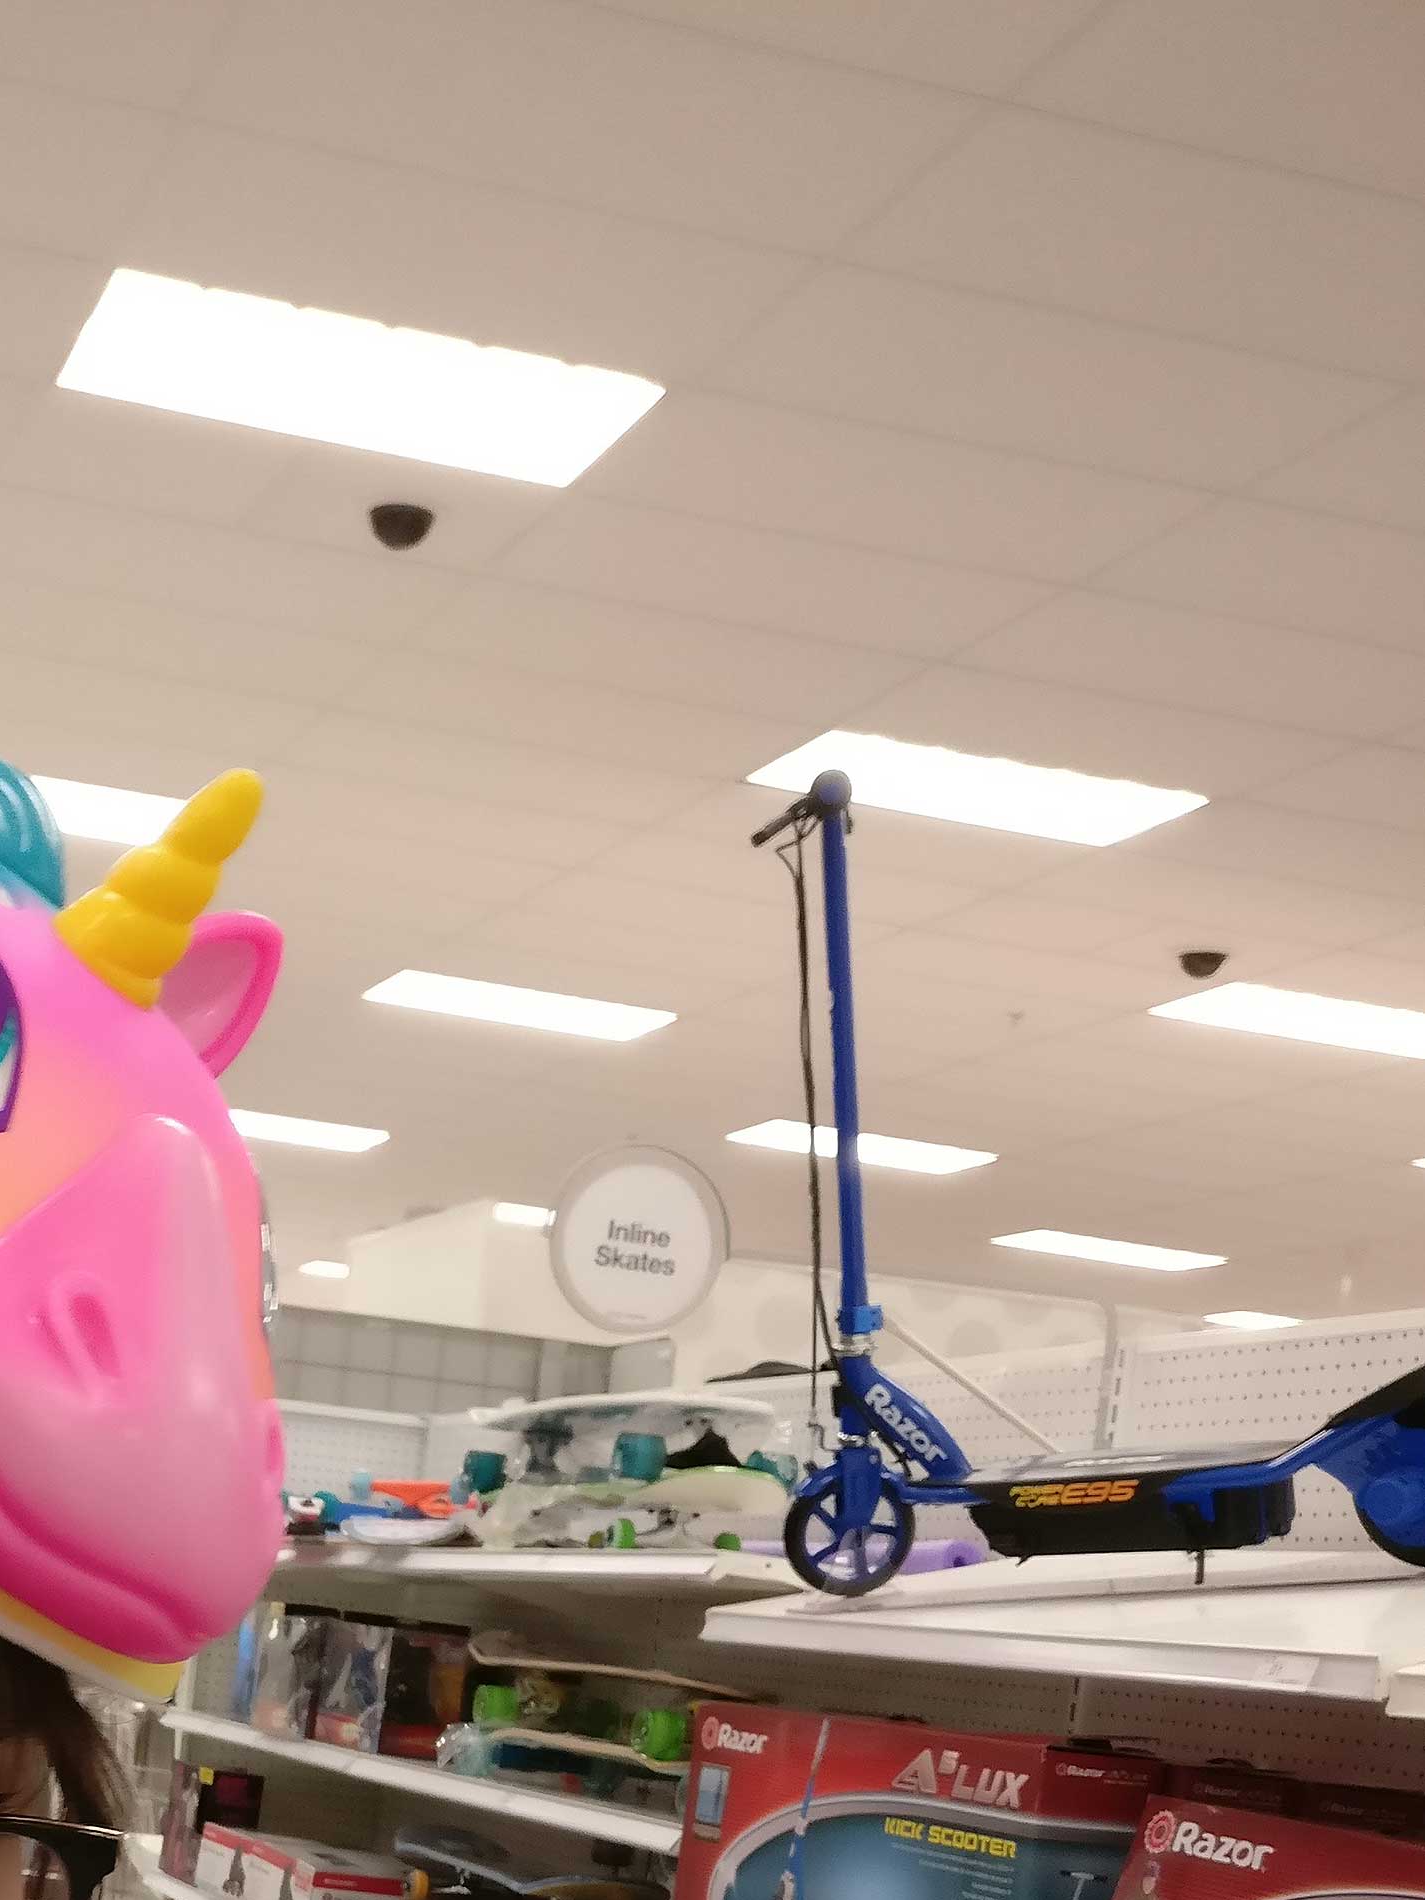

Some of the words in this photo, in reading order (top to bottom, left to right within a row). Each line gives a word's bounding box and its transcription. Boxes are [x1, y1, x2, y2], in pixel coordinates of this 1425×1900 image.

[607, 1220, 671, 1248] Inline
[594, 1245, 676, 1276] Skates
[865, 1383, 948, 1462] Razor
[1060, 1479, 1140, 1506] E95
[717, 1723, 768, 1754] Razor
[951, 1764, 1030, 1810] LUX
[884, 1816, 922, 1840] KICK
[928, 1825, 1017, 1859] SCOOTER
[1172, 1821, 1275, 1871] Razor
